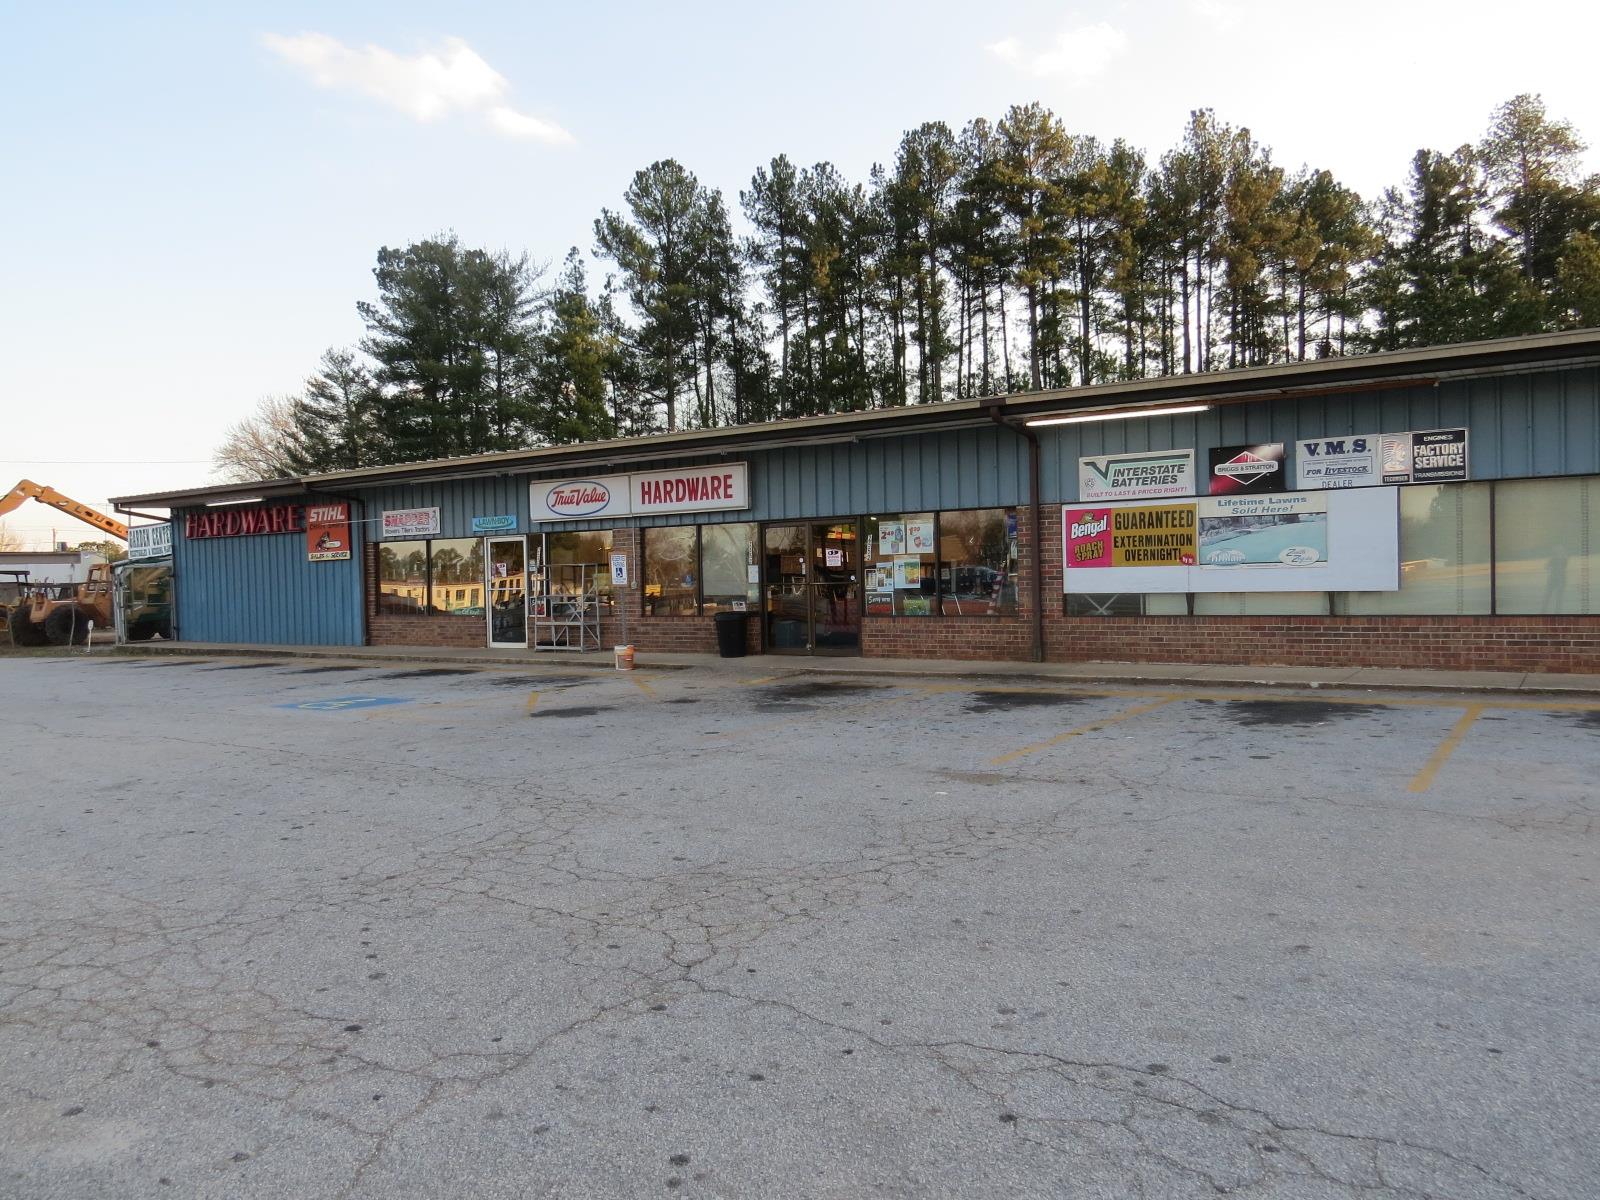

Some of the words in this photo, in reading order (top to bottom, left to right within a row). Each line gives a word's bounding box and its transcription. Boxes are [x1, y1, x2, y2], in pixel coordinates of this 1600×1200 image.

[1413, 441, 1465, 457] FACTORY
[1245, 463, 1275, 471] STRATTON
[1414, 454, 1464, 469] SERVICE
[1113, 463, 1186, 478] INTERSTATE
[1306, 468, 1322, 476] FOR
[1324, 465, 1369, 475] LIVESTOCK
[1414, 470, 1465, 478] TRANSMISSIONS
[1111, 475, 1178, 488] BATTERIES
[1322, 480, 1353, 489] DEALER
[551, 489, 575, 507] True
[574, 487, 606, 506] Value
[641, 474, 733, 505] HARDWARE
[1217, 499, 1264, 507] Lifetime
[1268, 496, 1307, 504] Lawns
[309, 506, 345, 522] STIHL
[1231, 507, 1257, 515] Sold
[1261, 504, 1294, 513] Here!
[186, 505, 303, 538] HARDWARE
[1070, 514, 1108, 539] Bengal
[1114, 509, 1194, 531] GUARANTEED
[1113, 533, 1193, 548] EXTERMINATION
[1124, 547, 1182, 562] OVERNIGHT!
